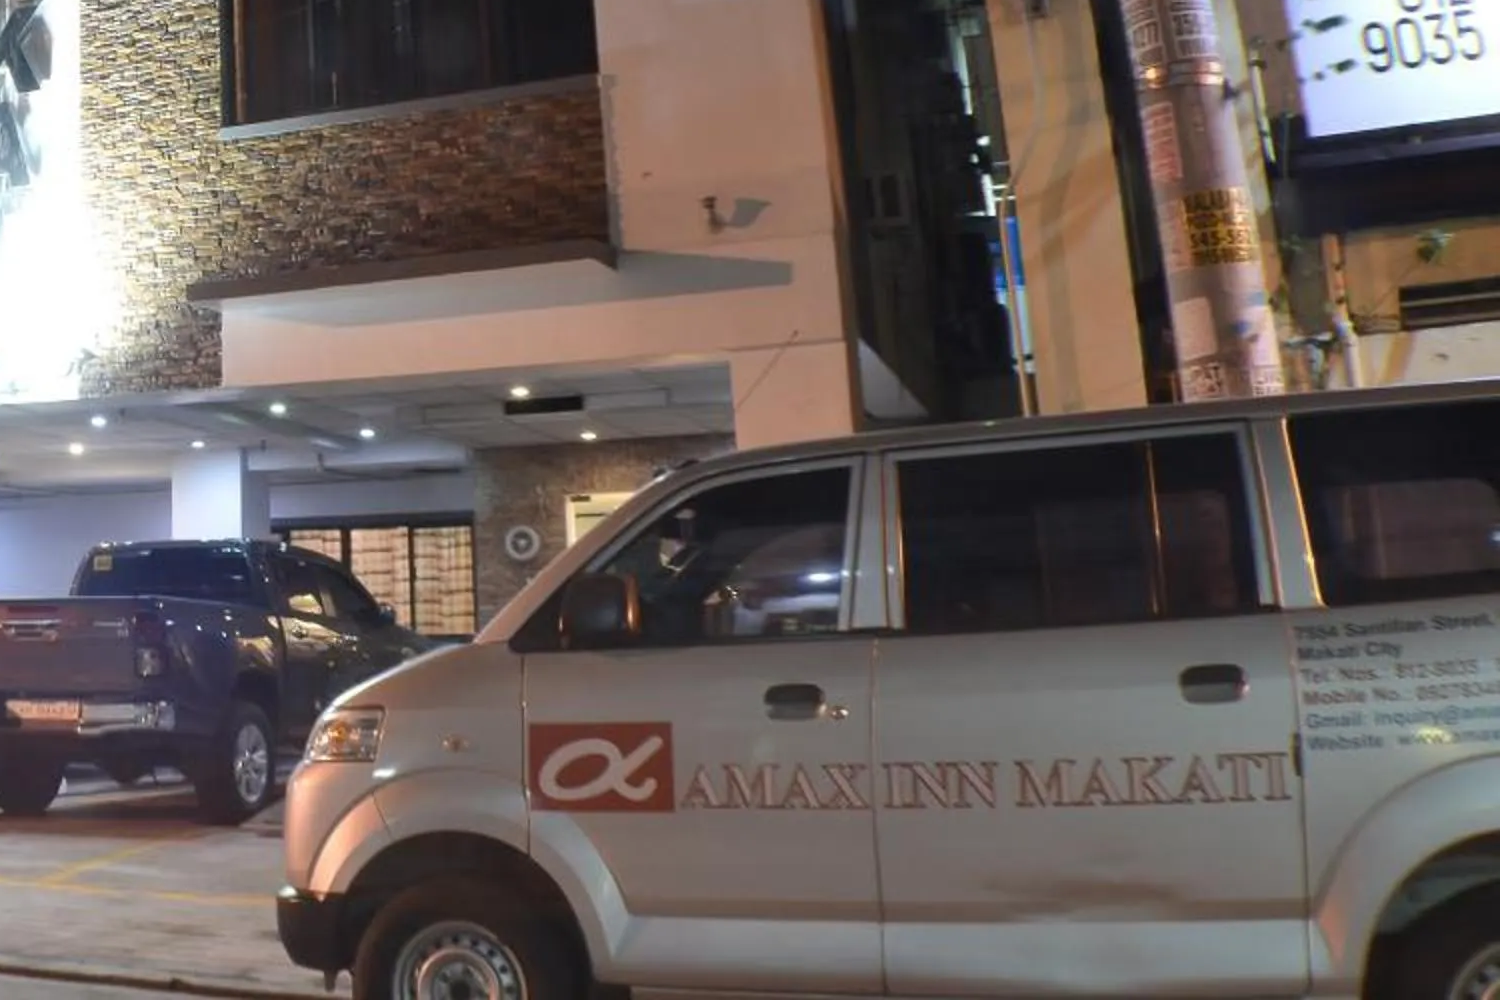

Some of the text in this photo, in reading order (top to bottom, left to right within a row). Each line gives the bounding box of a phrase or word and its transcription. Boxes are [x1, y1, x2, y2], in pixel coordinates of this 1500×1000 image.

[1361, 9, 1486, 73] 9035
[680, 750, 1293, 811] AMAX INN MAKATI
